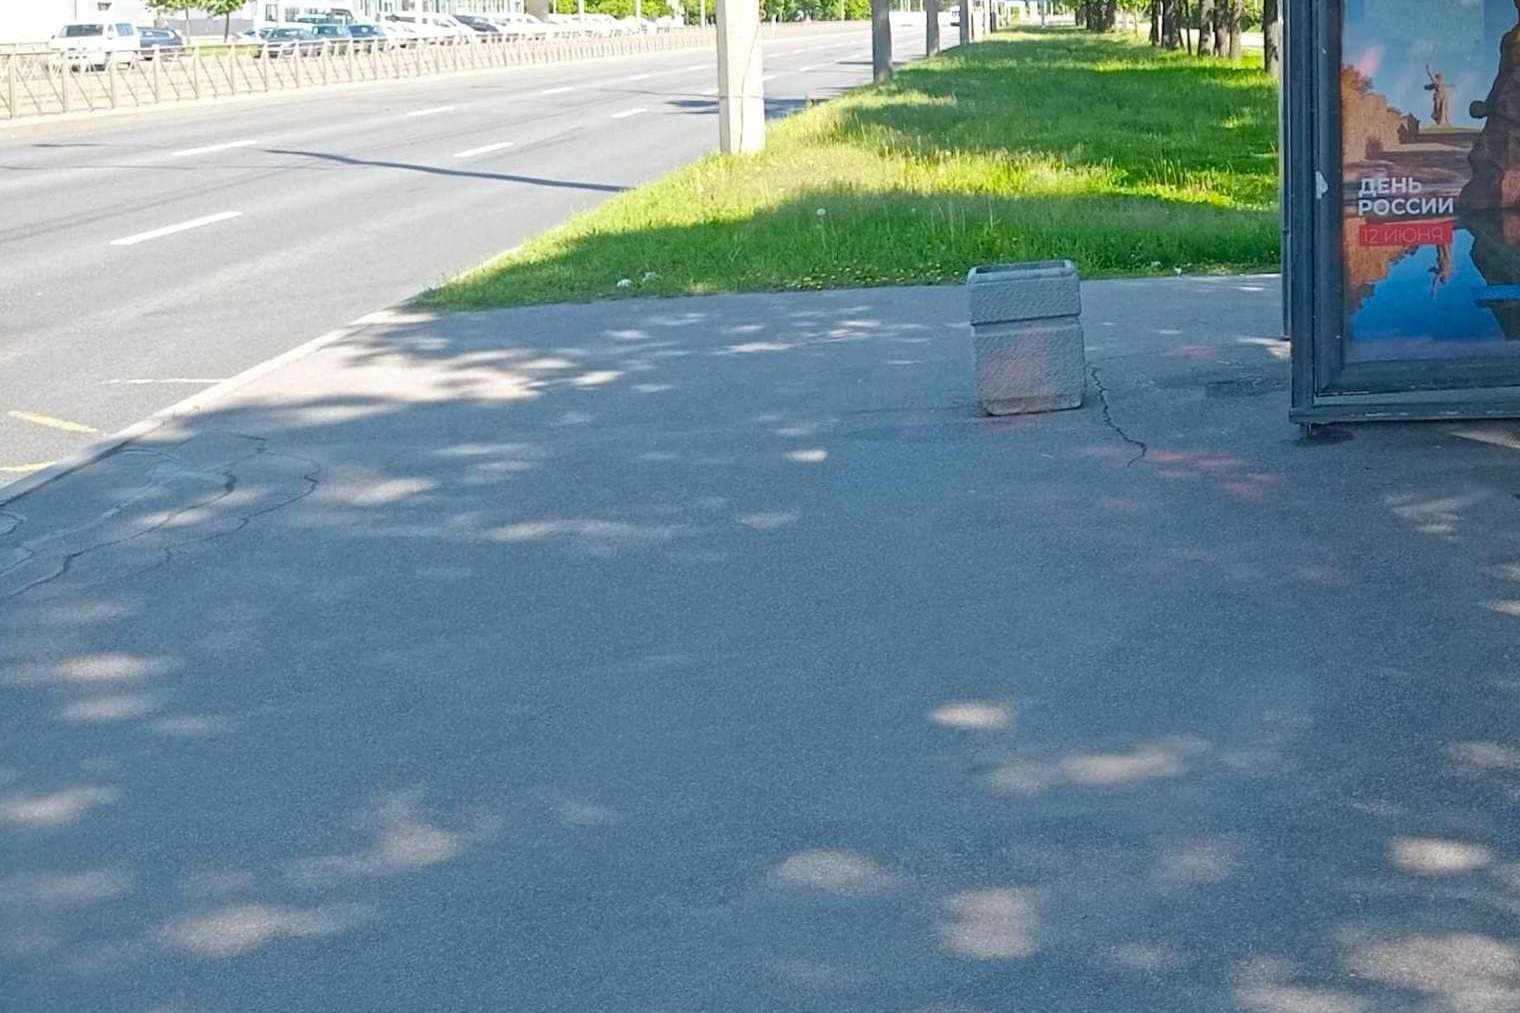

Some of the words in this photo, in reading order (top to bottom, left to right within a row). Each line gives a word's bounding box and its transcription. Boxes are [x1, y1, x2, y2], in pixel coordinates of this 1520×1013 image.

[1358, 177, 1422, 197] ДЕНЬ
[1358, 197, 1454, 216] РОССИИ
[1363, 228, 1379, 244] 12
[1384, 226, 1444, 243] ИЮНЯ
